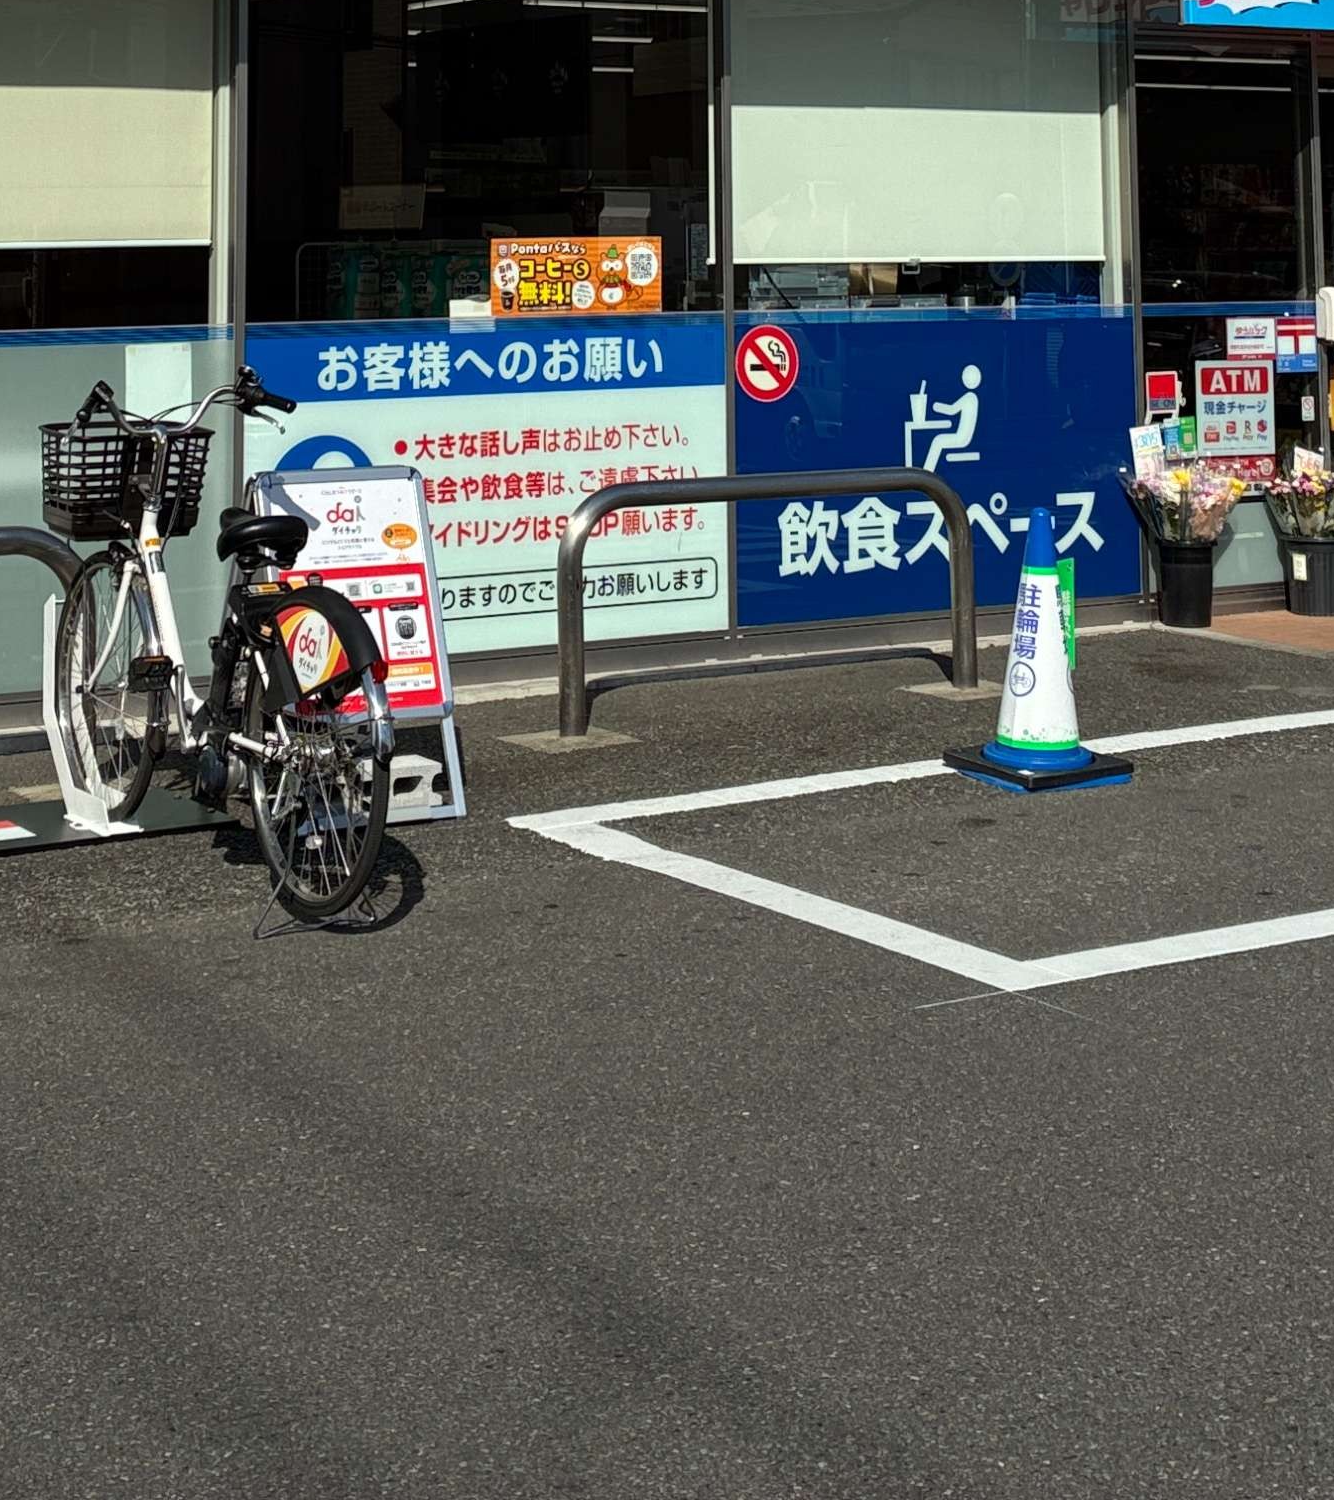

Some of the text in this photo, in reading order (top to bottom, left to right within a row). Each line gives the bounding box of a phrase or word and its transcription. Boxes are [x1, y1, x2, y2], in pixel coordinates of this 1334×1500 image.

[317, 337, 664, 392] お客様へのお願い
[1209, 369, 1262, 394] ATM
[1203, 400, 1267, 415] 現金チャージ
[414, 423, 690, 461] 大きな話し声はお止め下さい。
[778, 491, 1105, 577] 飲食スペース
[441, 567, 709, 610] りますのでご力お願いします
[1013, 583, 1043, 660] 駐輪場
